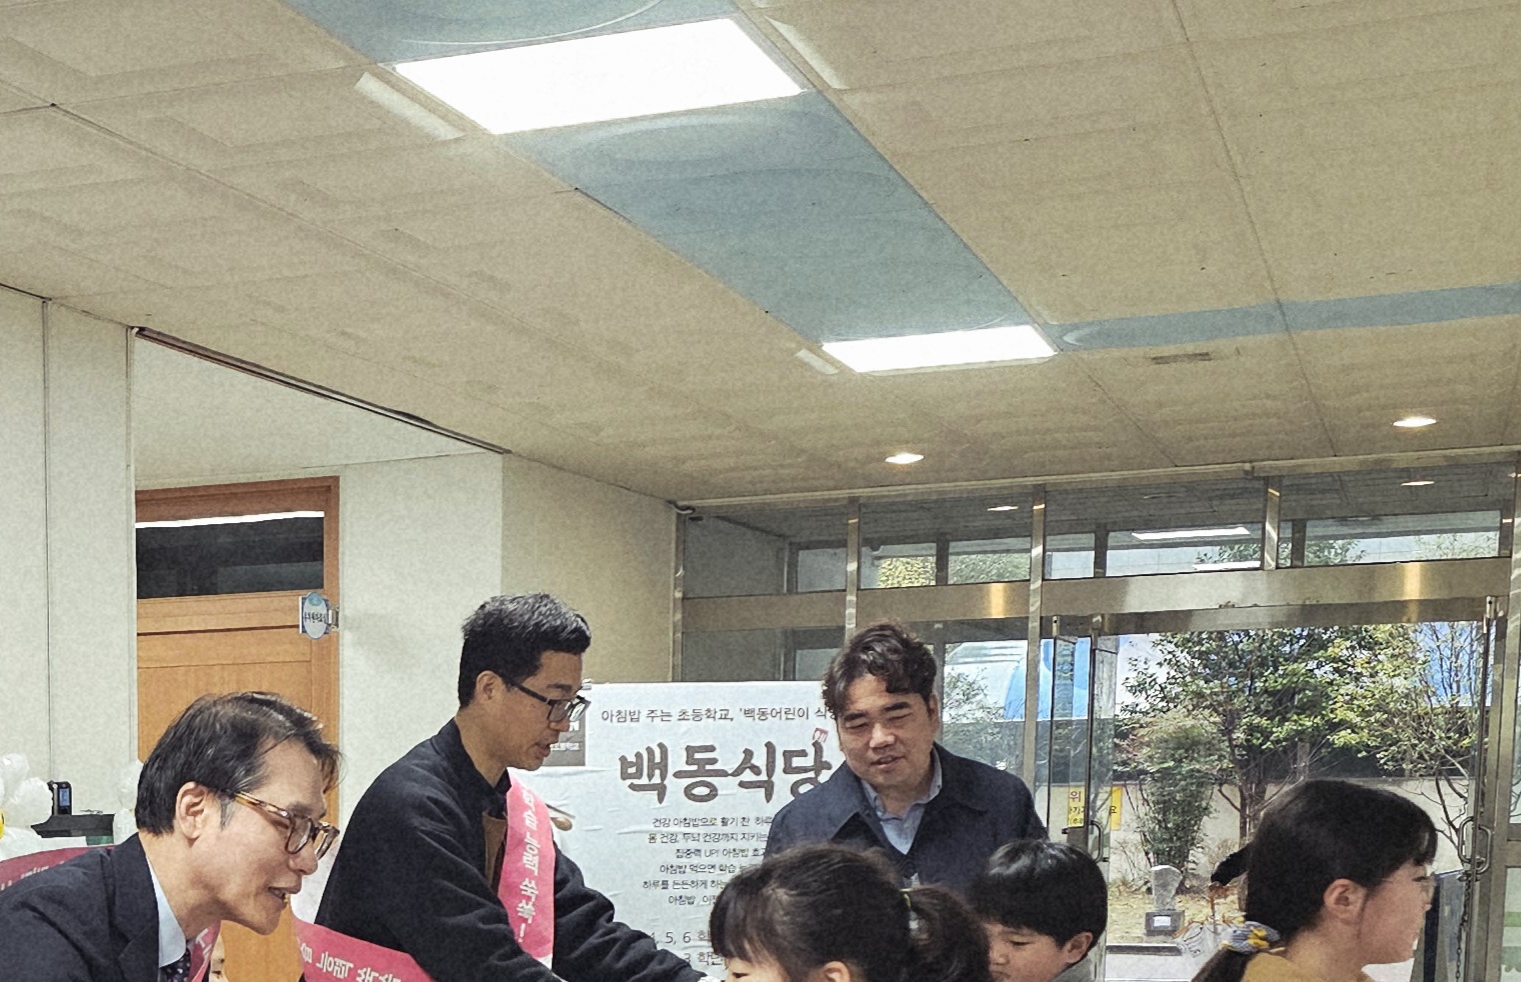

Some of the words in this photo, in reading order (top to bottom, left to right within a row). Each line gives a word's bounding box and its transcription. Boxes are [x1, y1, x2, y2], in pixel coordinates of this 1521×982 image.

[601, 709, 641, 723] 아침밥
[645, 709, 673, 723] 주는
[677, 707, 734, 723] 초등학교,
[618, 740, 833, 804] 백동식당
[652, 817, 671, 828] 건강
[672, 816, 718, 828] 아침밥으로
[722, 848, 750, 859] 아침밥
[659, 864, 687, 875] 아침밥
[642, 880, 670, 891] 하루를
[682, 930, 692, 944] 6
